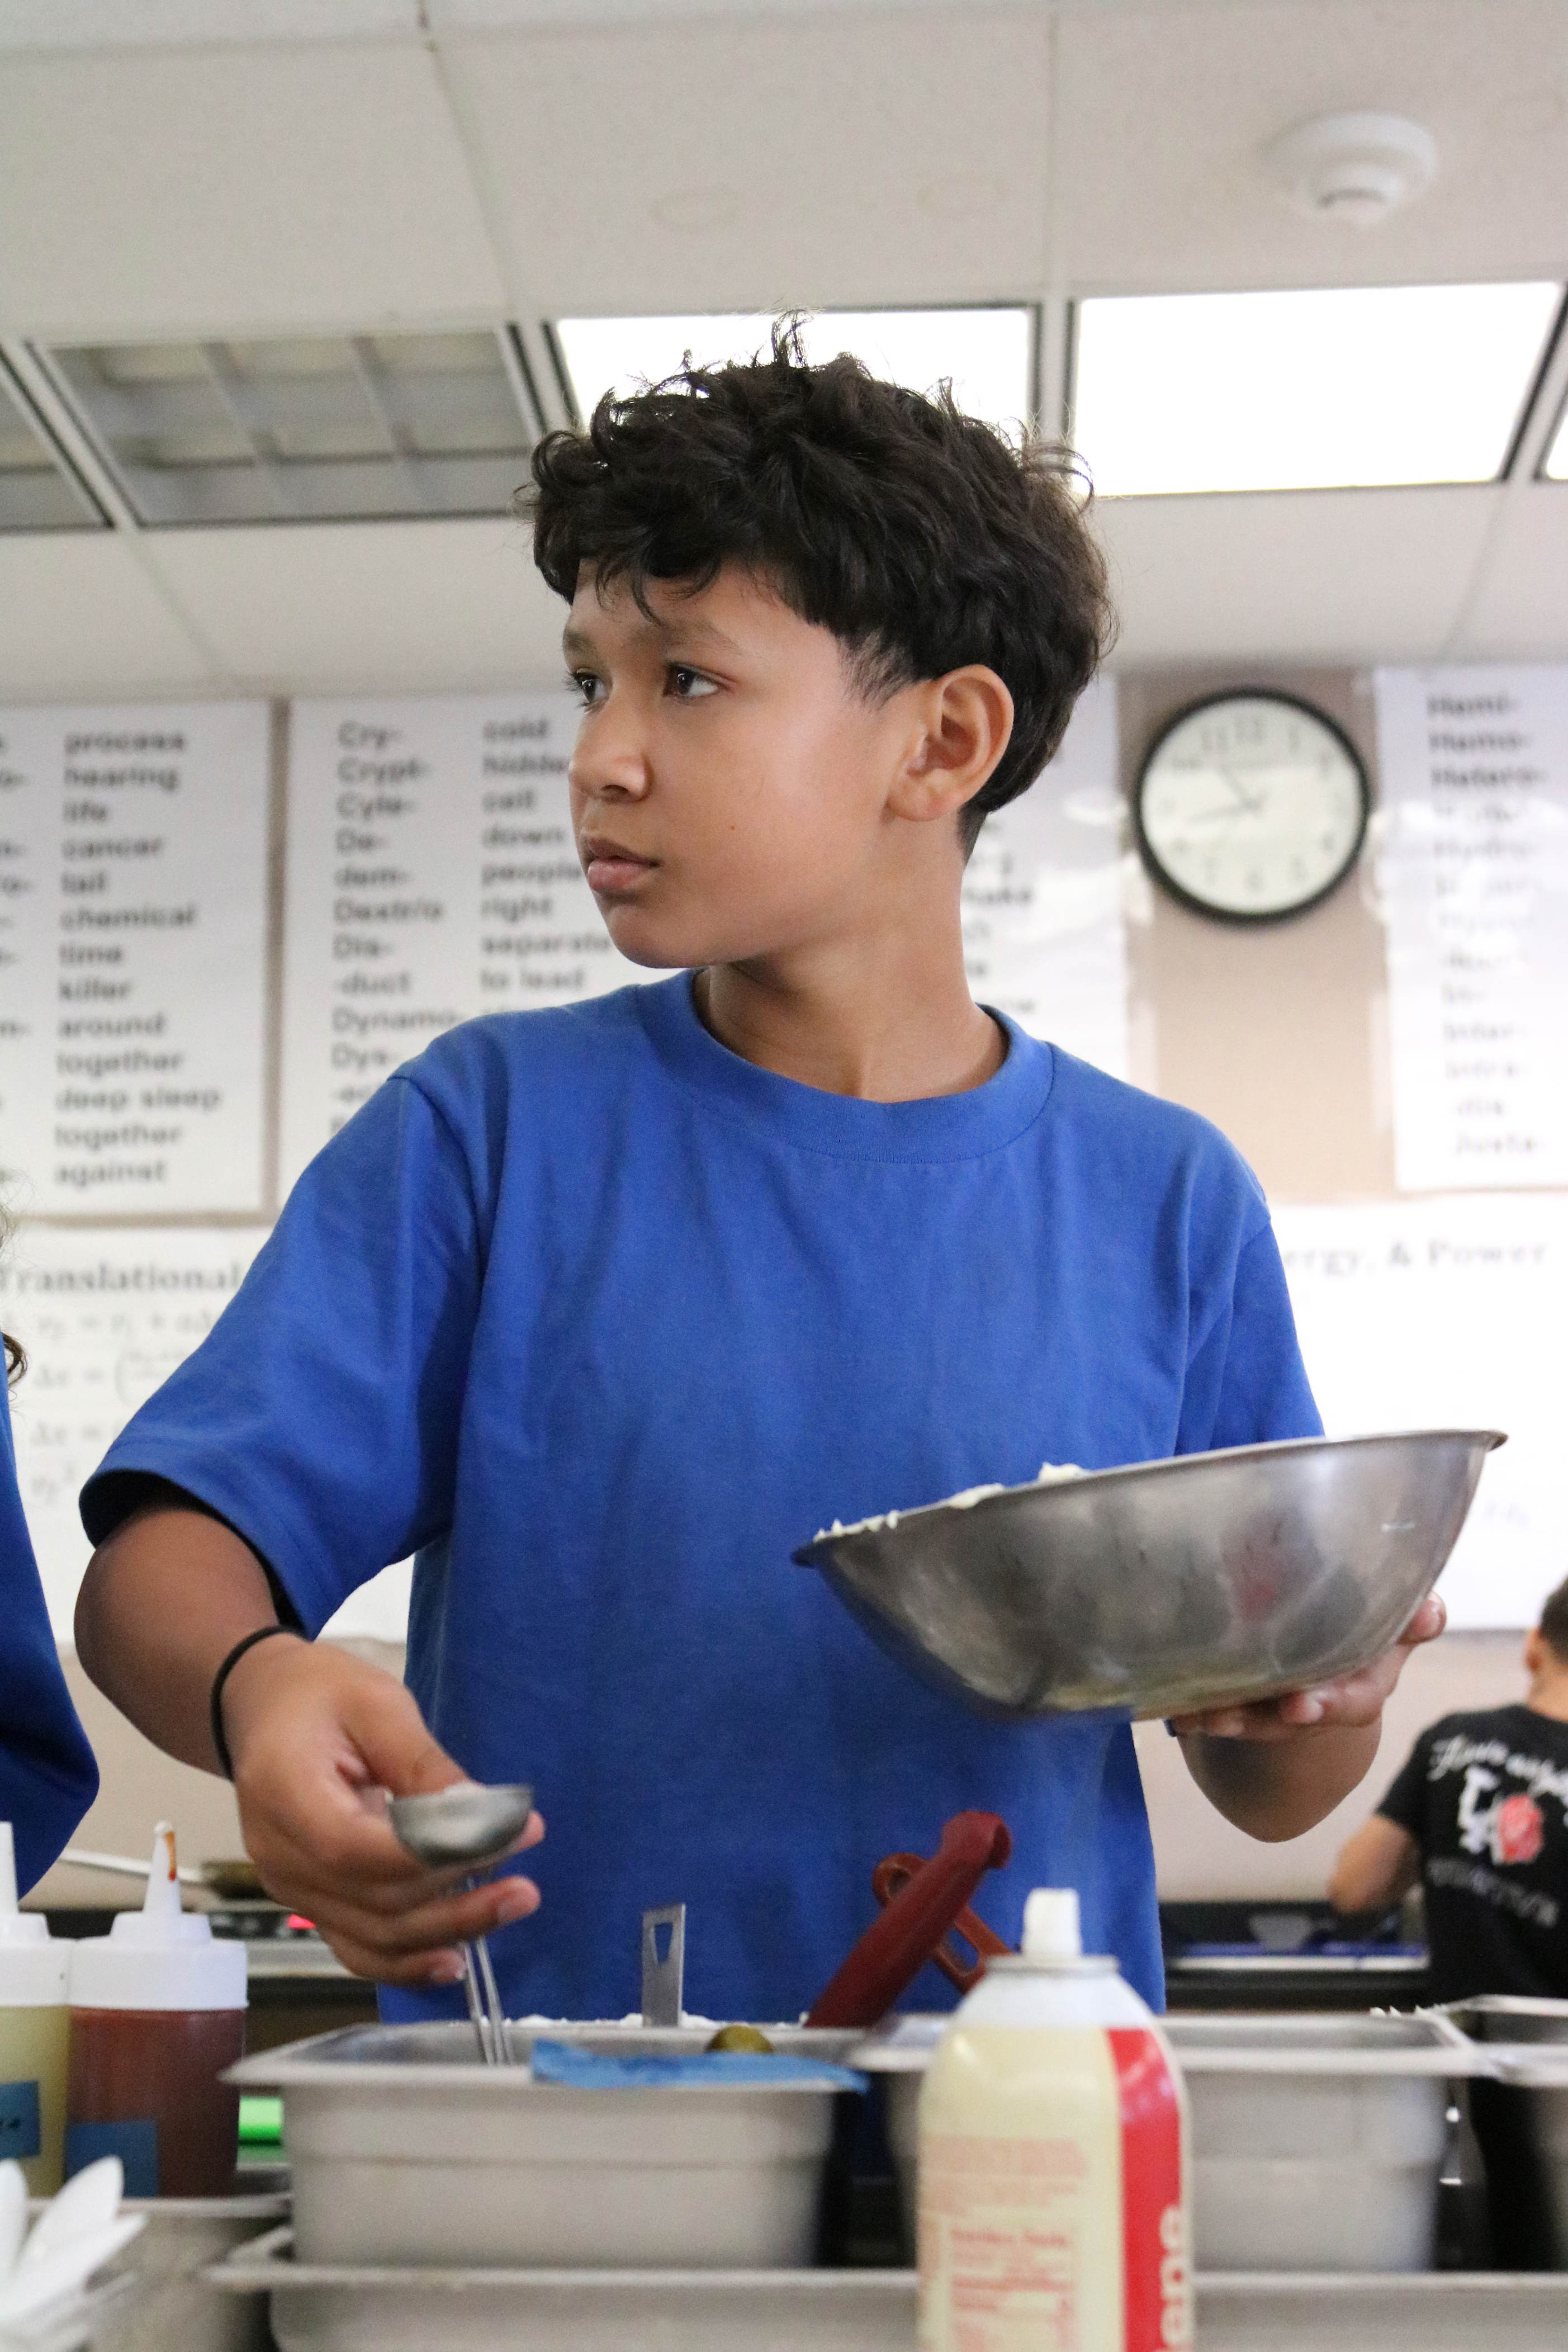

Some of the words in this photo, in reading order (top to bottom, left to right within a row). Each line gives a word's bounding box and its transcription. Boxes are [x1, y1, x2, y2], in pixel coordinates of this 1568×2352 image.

[64, 731, 188, 758] process
[482, 753, 567, 777] hidde
[64, 765, 181, 794] hearing
[62, 837, 164, 860] cancer
[60, 903, 198, 930] chemical
[58, 977, 132, 1001] killer
[58, 1011, 167, 1039] around
[56, 1048, 185, 1080] together
[54, 1122, 183, 1154] together
[55, 1159, 167, 1190] against
